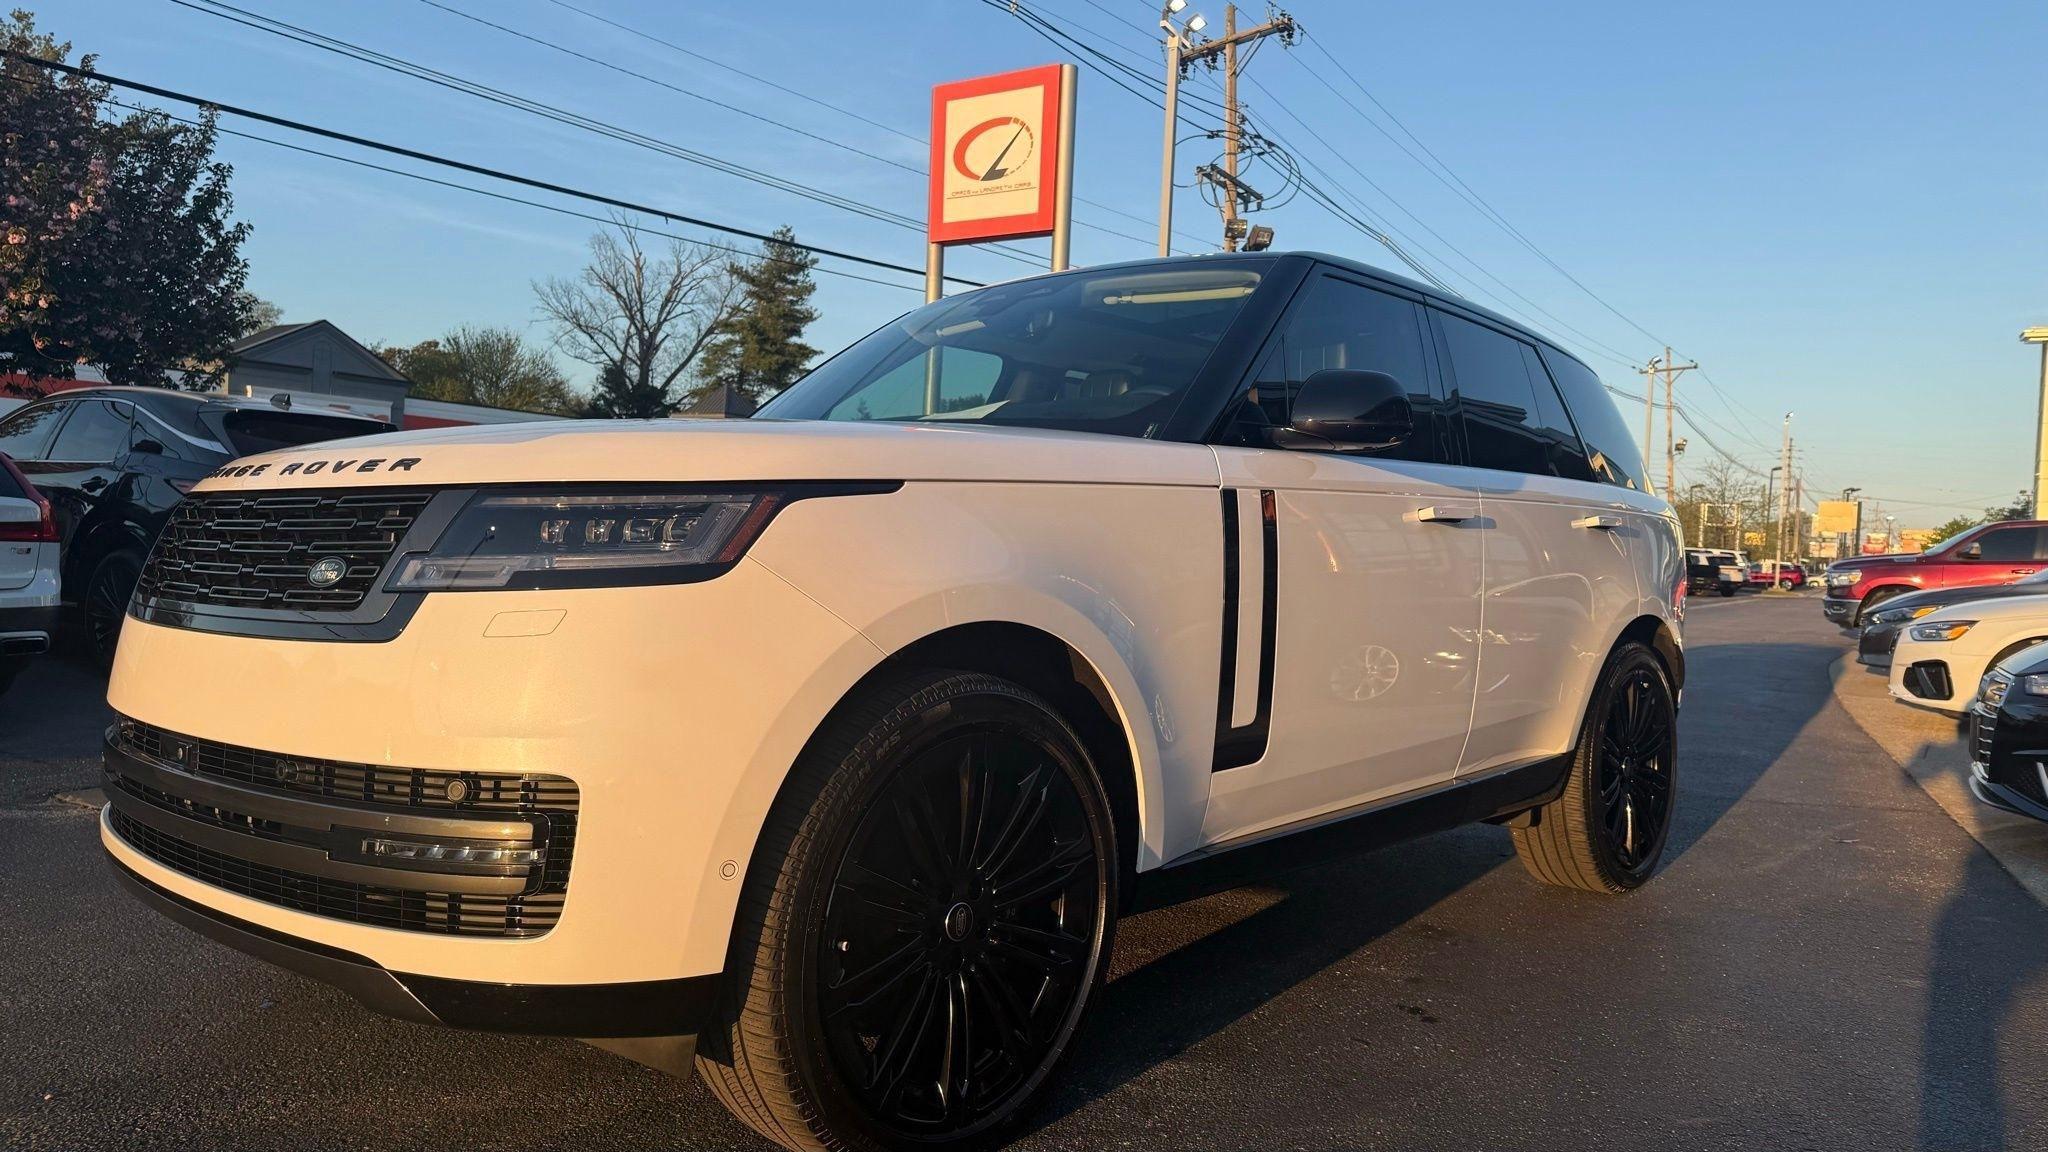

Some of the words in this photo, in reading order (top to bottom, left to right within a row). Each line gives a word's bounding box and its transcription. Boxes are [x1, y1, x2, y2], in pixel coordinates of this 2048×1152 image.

[206, 463, 273, 479] ANGE
[278, 457, 422, 476] ROVER
[315, 570, 338, 580] ROVER
